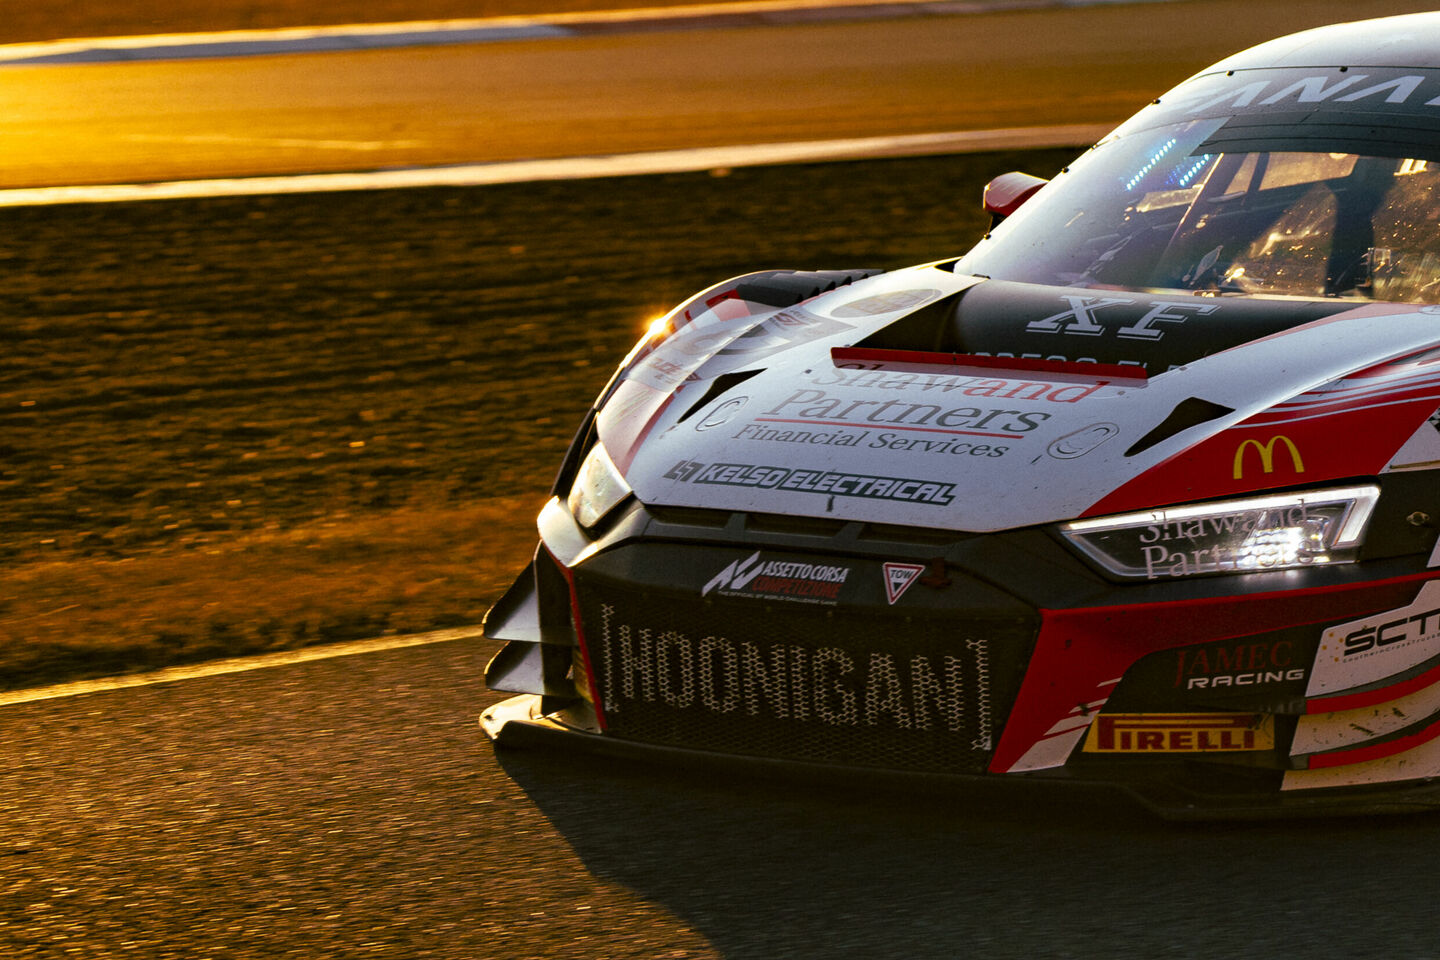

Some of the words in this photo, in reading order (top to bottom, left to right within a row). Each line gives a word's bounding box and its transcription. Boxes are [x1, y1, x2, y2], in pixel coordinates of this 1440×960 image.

[1025, 296, 1222, 341] XF
[762, 388, 1053, 433] Partners
[732, 423, 870, 448] Financial
[870, 433, 1009, 459] Services
[701, 465, 780, 490] KELSO
[786, 469, 957, 506] ELECTRICAL
[752, 578, 844, 598] COMPETIZIONE
[890, 569, 914, 579] TOW
[1174, 641, 1293, 688] JAMEC
[1187, 669, 1304, 690] RACING
[1097, 715, 1262, 750] PIRELLI
